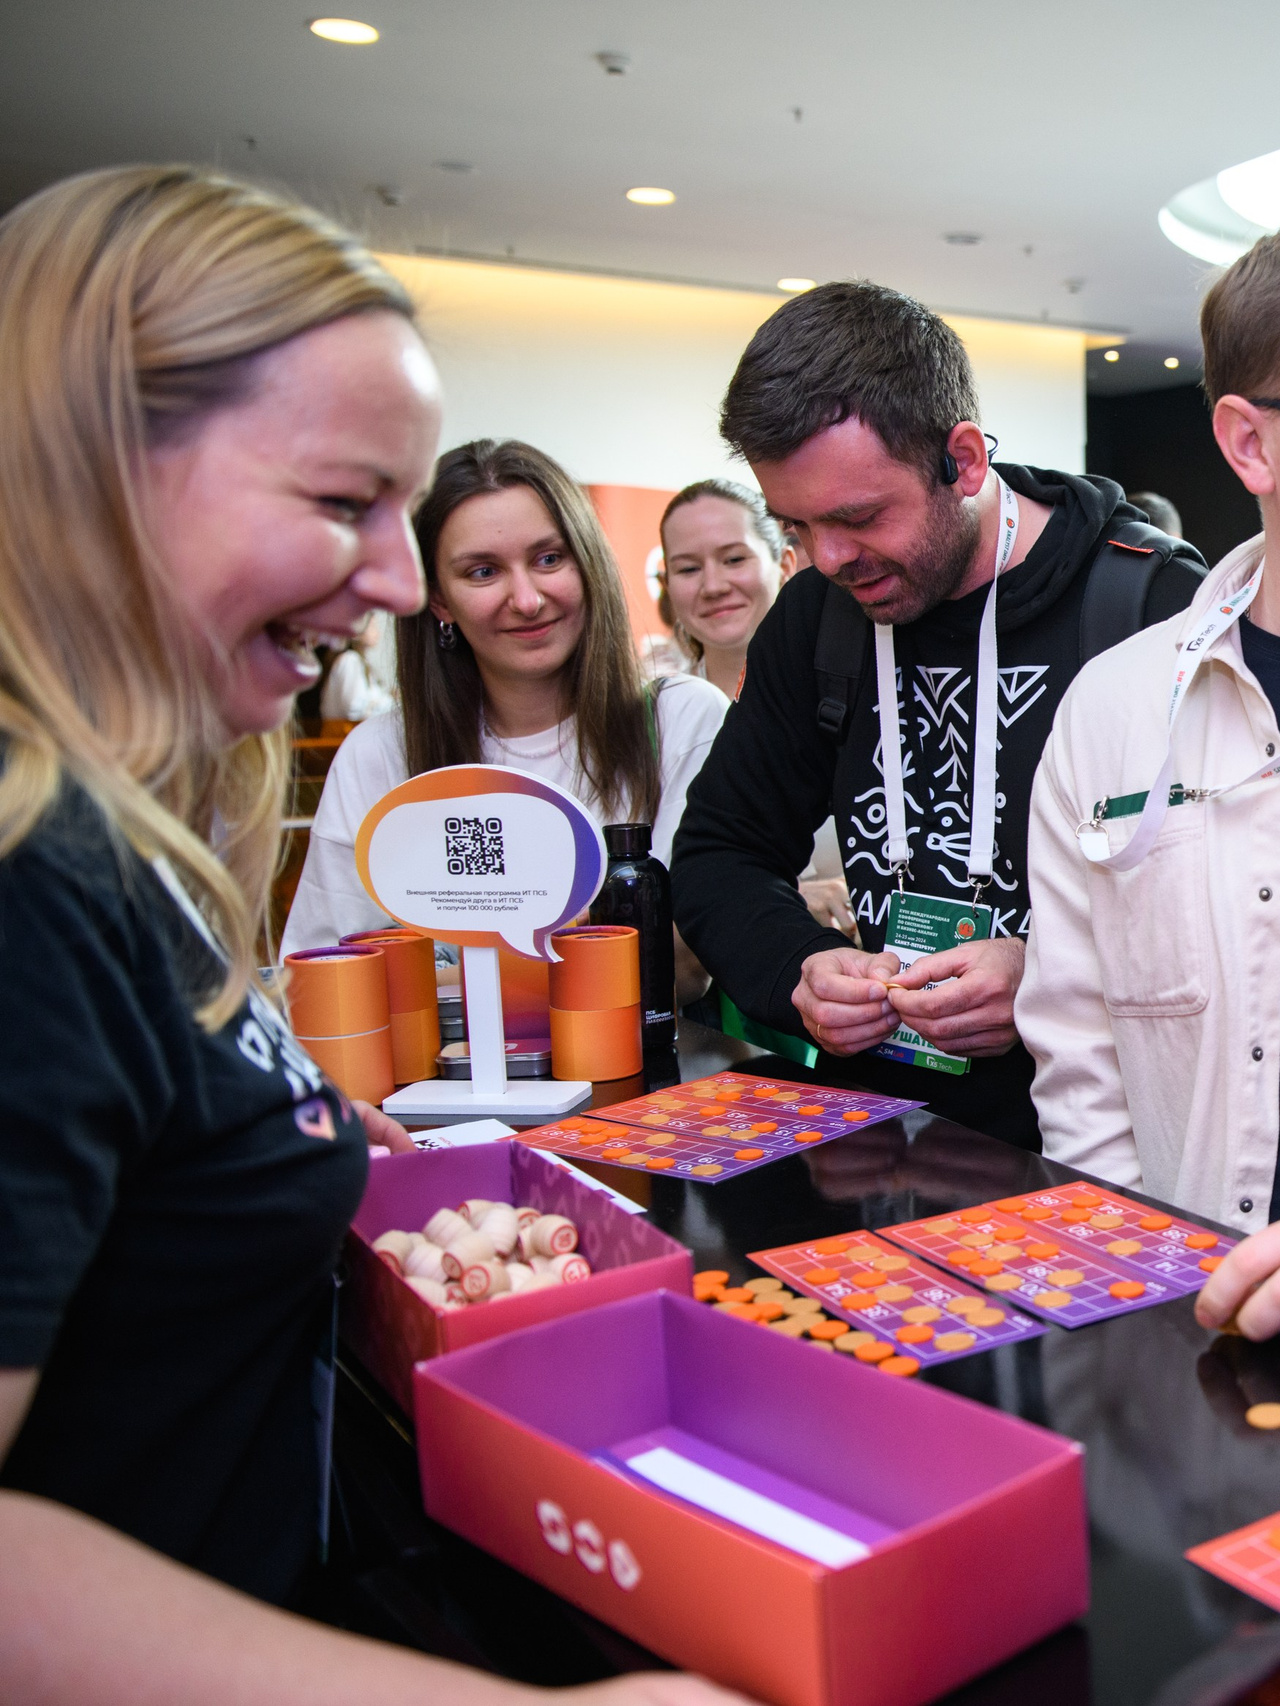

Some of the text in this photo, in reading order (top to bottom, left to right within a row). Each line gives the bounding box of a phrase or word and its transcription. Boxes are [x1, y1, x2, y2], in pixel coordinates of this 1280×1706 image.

[1201, 623, 1217, 639] Tech
[438, 889, 482, 897] реферальная
[895, 940, 936, 951] САНКТ-ПЕТЕРБУРГ
[938, 1062, 953, 1072] Tech
[793, 1123, 811, 1131] 17
[775, 1129, 794, 1137] 13
[697, 1156, 718, 1164] 19
